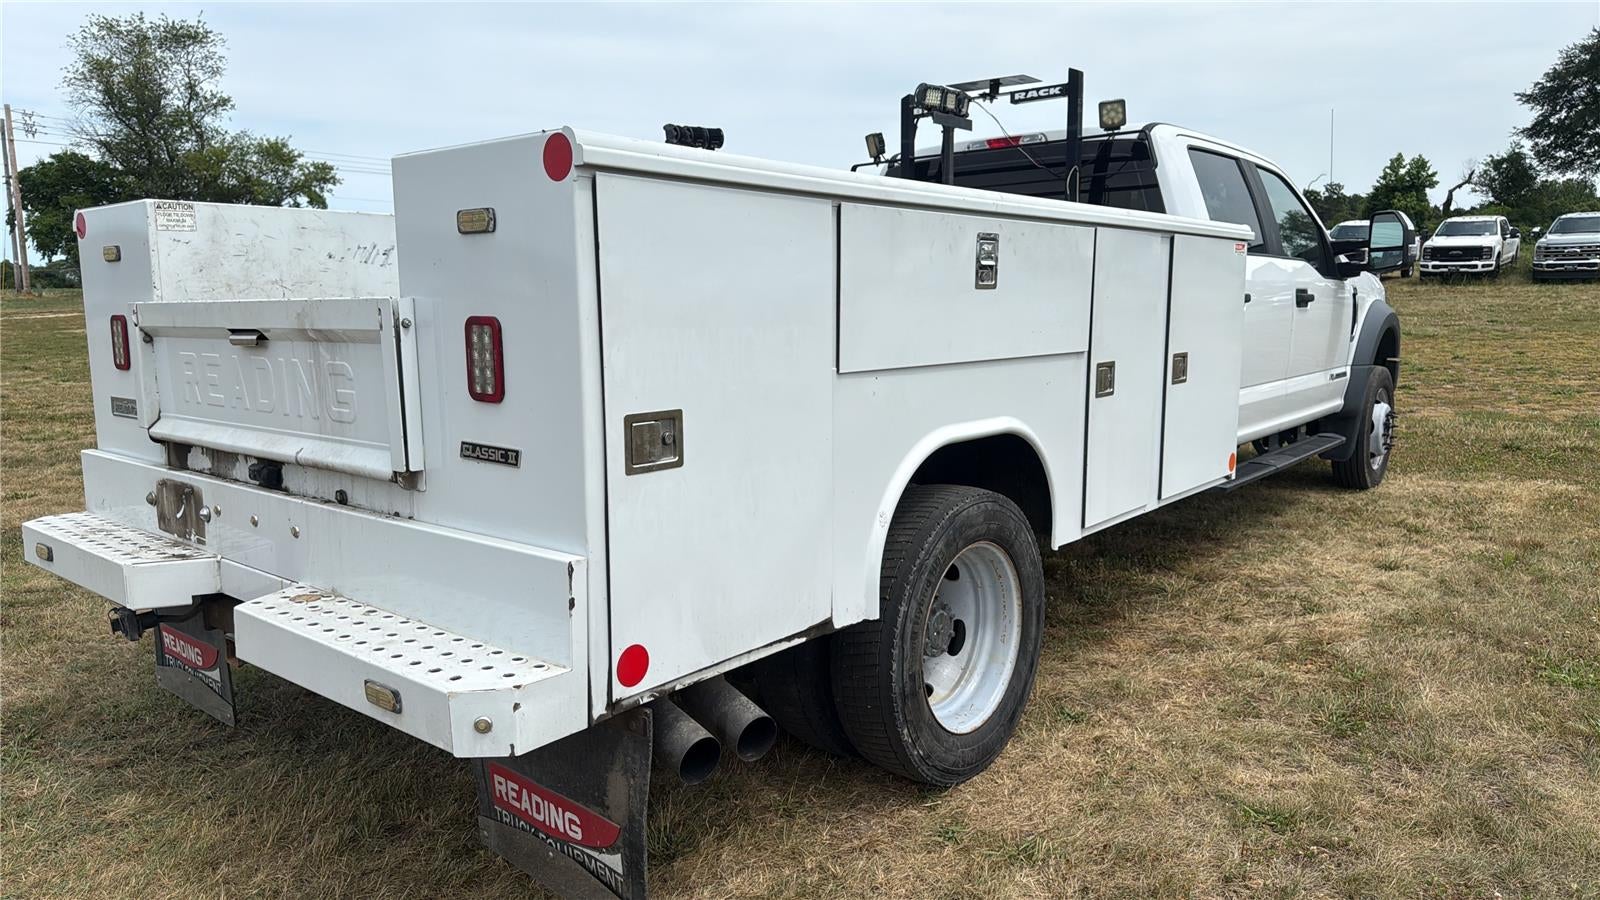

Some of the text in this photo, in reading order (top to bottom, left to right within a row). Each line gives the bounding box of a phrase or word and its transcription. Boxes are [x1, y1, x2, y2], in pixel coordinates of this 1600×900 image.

[1014, 87, 1062, 100] RACK
[162, 202, 194, 210] CAUTION
[179, 351, 357, 425] READING
[462, 444, 517, 464] CLASSIC II
[162, 631, 203, 666] READING
[493, 773, 583, 841] READING
